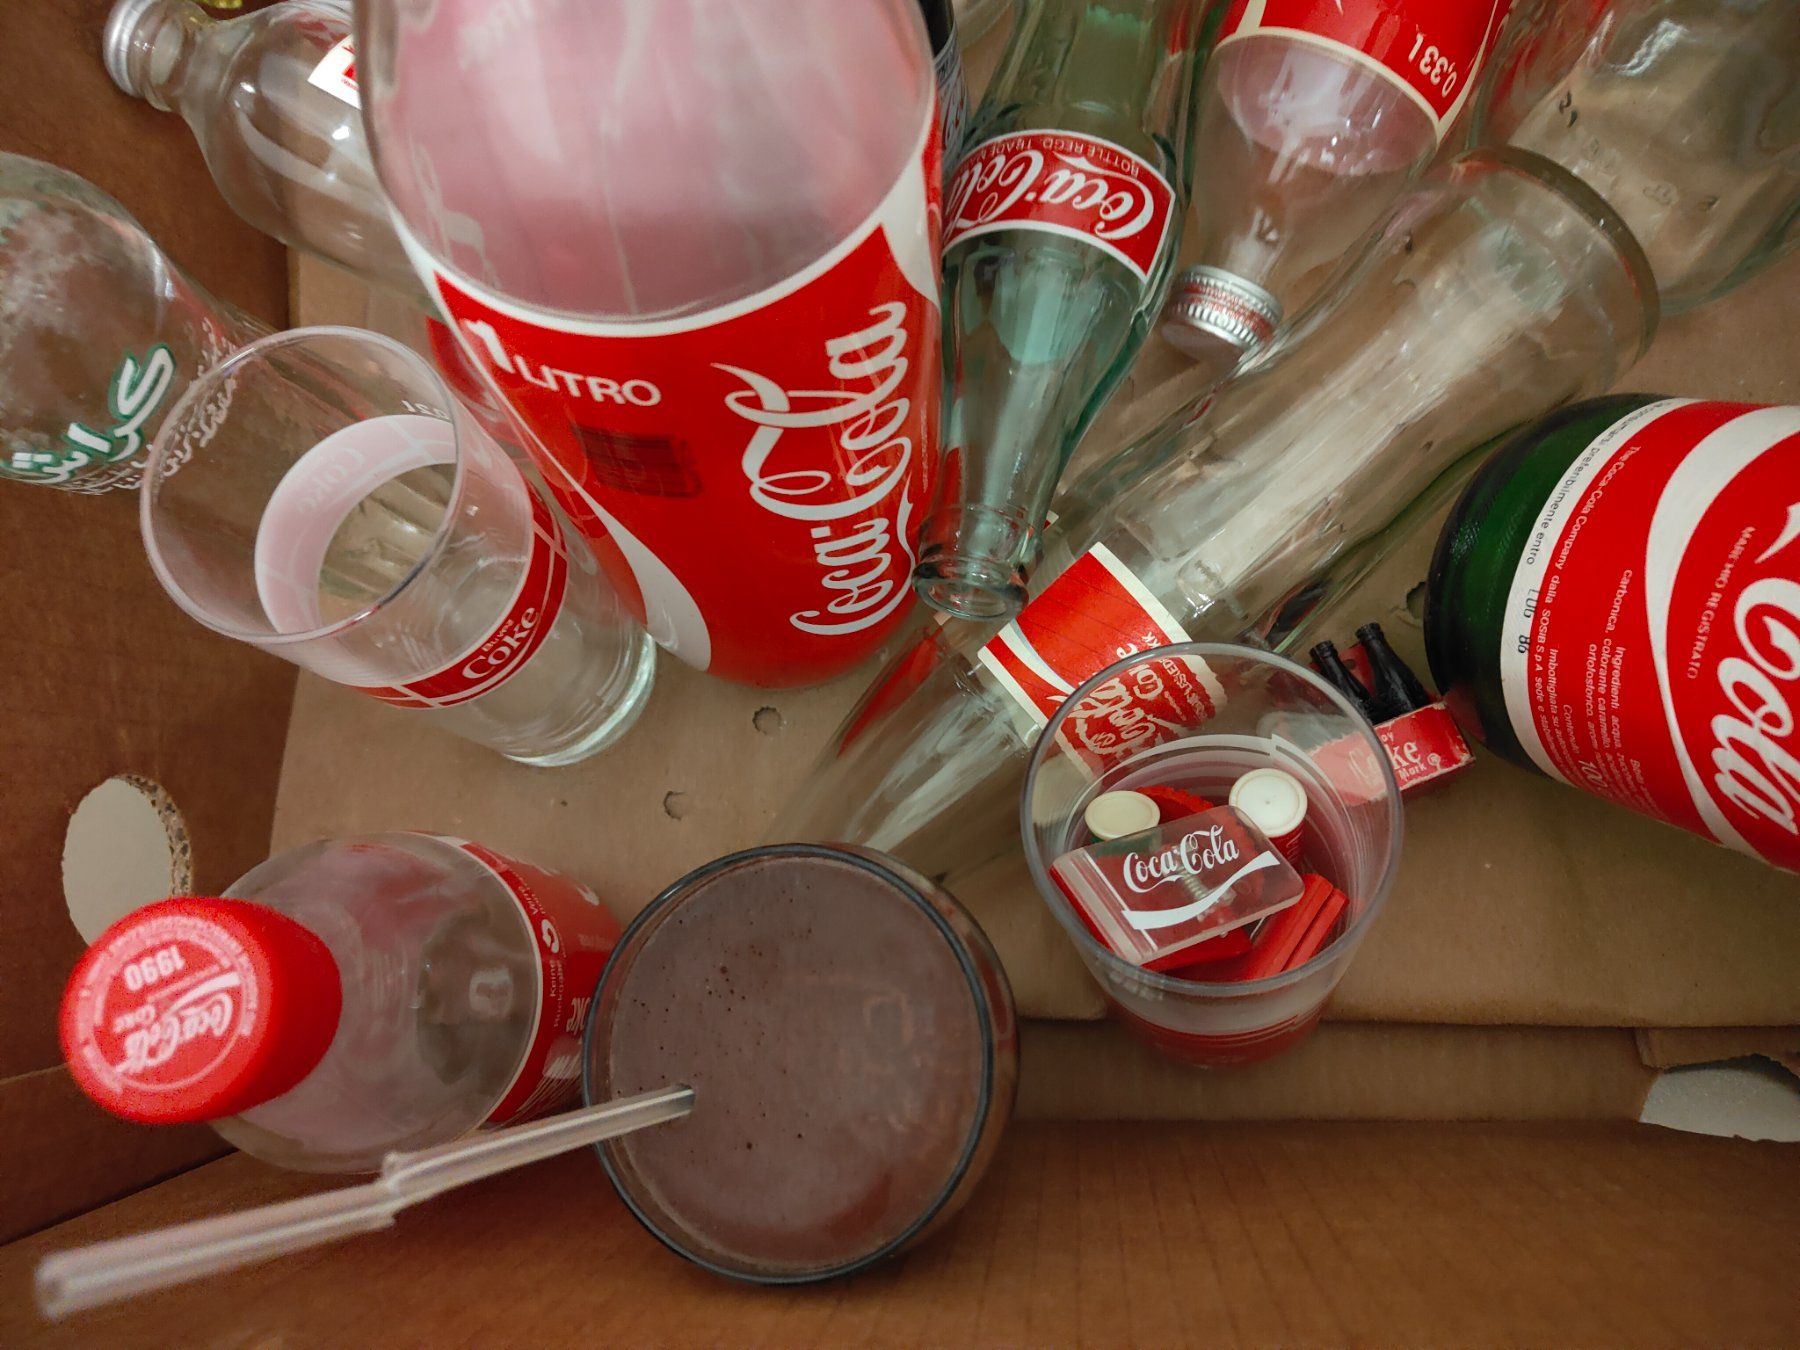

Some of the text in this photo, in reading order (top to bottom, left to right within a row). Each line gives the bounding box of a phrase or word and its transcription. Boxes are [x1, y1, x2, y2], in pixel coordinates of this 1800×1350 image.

[1419, 45, 1458, 98] 0,33
[1087, 143, 1140, 178] BOTTLE
[513, 354, 662, 407] LITRO
[709, 300, 917, 636] Coca-Cola
[1581, 461, 1625, 514] Coca-Cola
[1526, 531, 1545, 565] entro
[1555, 515, 1588, 570] Company
[1544, 575, 1560, 604] dalla
[1686, 526, 1756, 681] MARCHIO REGISTRATO
[462, 607, 540, 679] Coke
[1597, 638, 1613, 695] colorante
[1122, 824, 1240, 893] Coca-Cola
[123, 944, 186, 992] 1990
